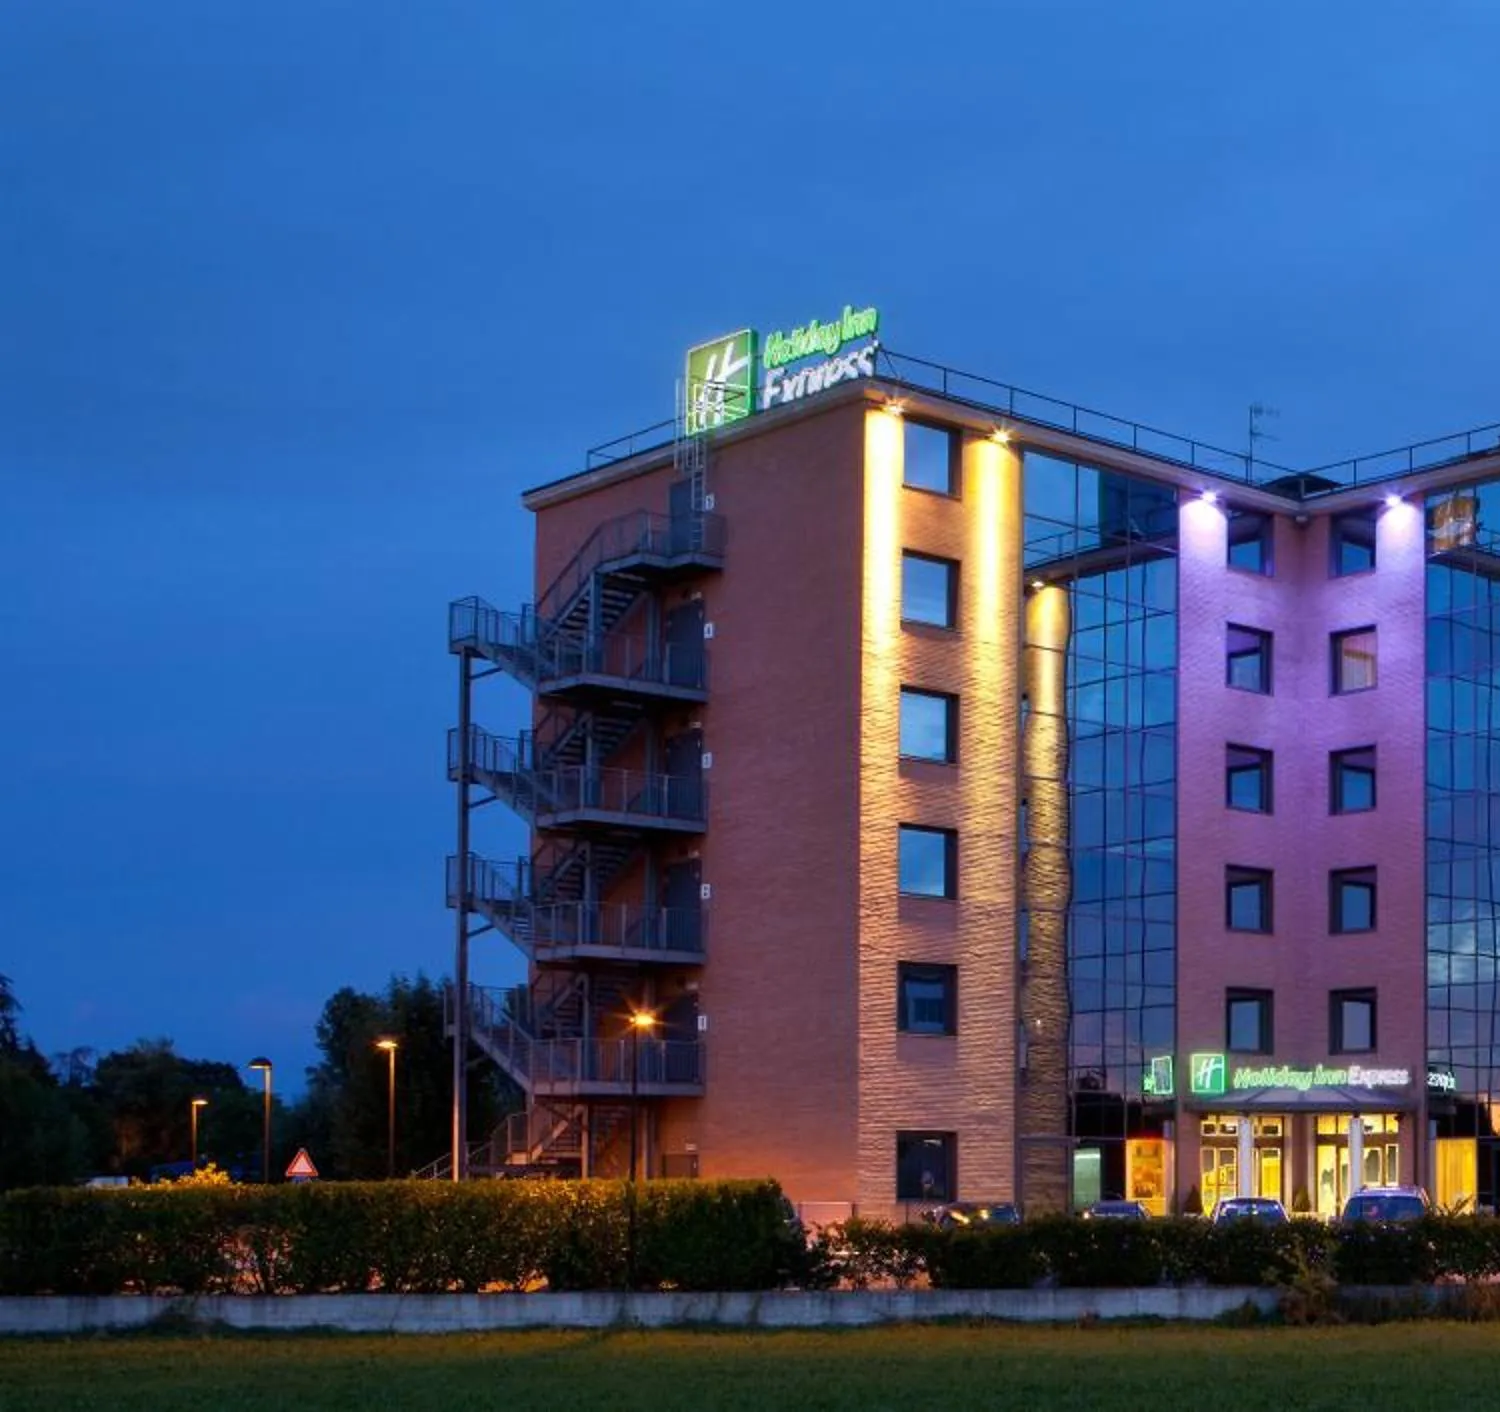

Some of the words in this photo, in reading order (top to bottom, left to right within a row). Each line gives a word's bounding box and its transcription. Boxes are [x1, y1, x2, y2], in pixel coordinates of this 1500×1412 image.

[1233, 1065, 1312, 1091] Holiday
[1313, 1063, 1347, 1085] Inn
[1347, 1065, 1410, 1089] Express
